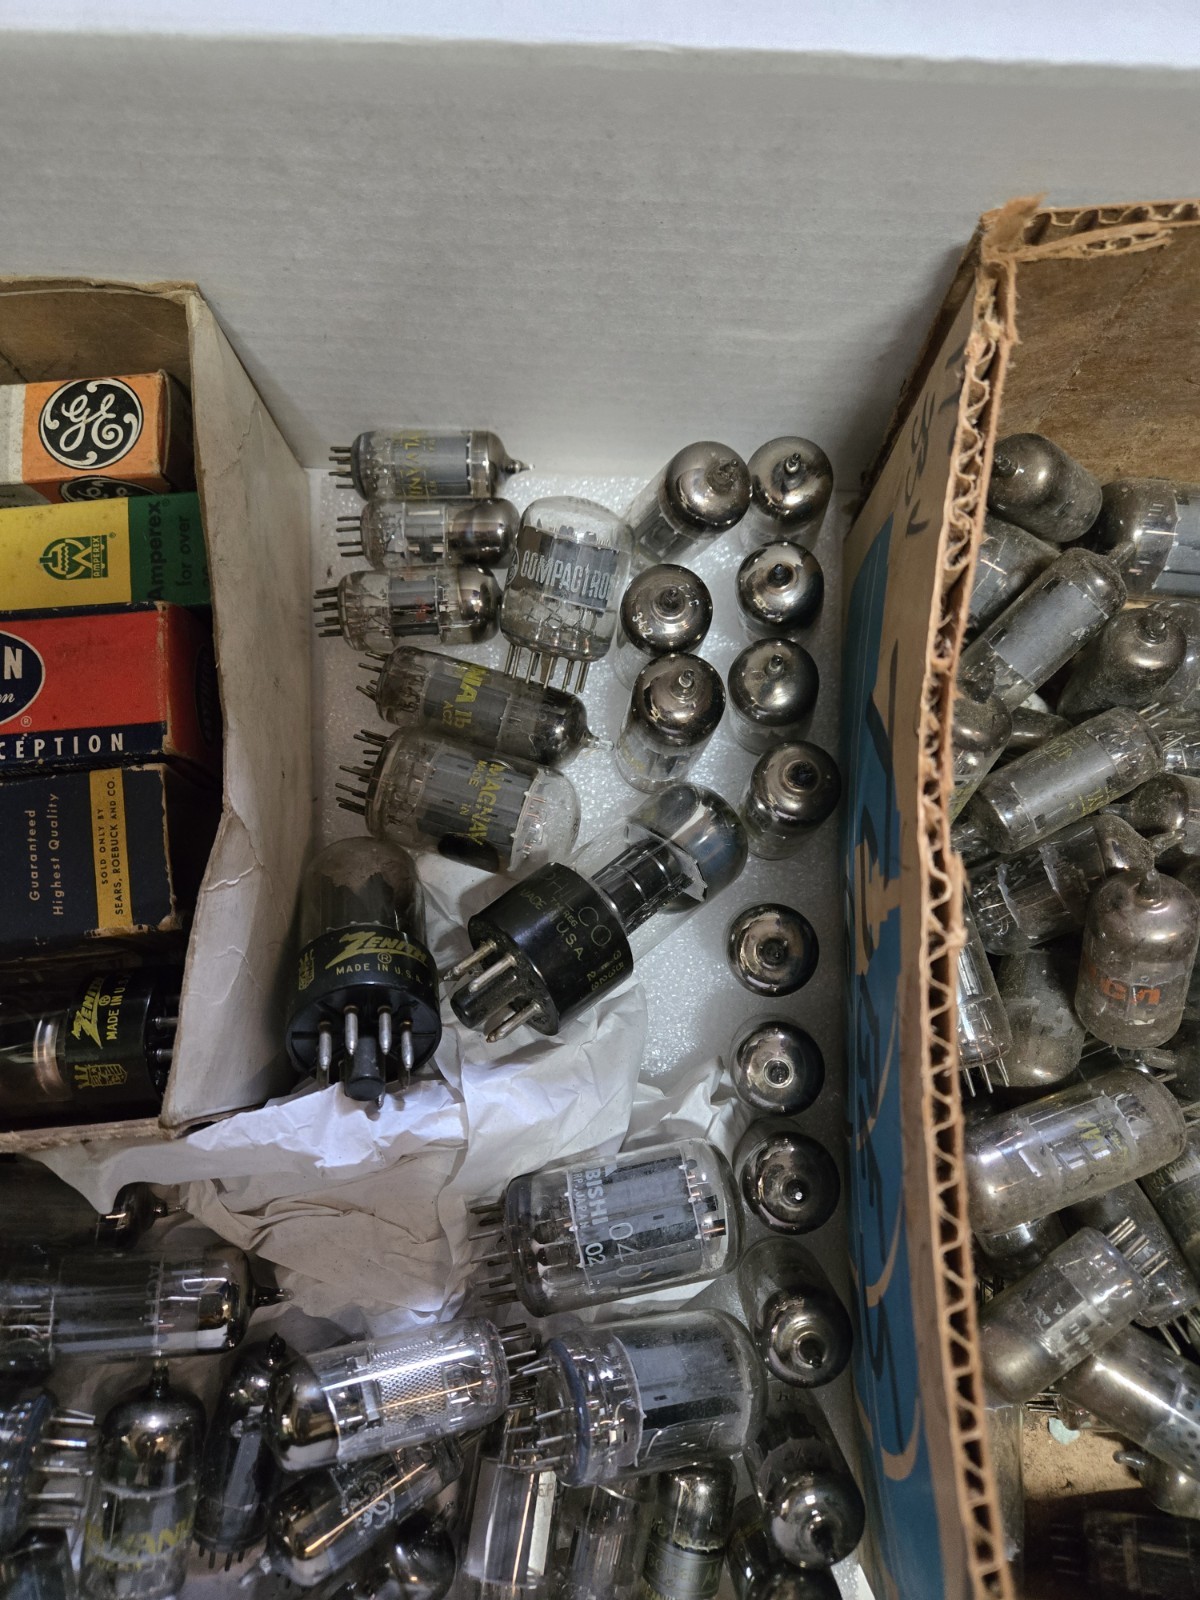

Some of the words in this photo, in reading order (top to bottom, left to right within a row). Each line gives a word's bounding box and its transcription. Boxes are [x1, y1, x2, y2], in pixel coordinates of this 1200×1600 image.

[147, 501, 168, 600] Amperex
[178, 515, 193, 554] over
[93, 535, 101, 578] AMPEREX
[176, 561, 193, 587] for
[107, 776, 116, 796] CO.
[48, 793, 60, 850] Quality
[97, 808, 104, 821] BY
[110, 800, 118, 820] AND
[25, 810, 41, 900] Guaranteed
[98, 825, 107, 858] ONLY
[111, 823, 121, 876] ROEBUCK
[51, 862, 64, 915] Highest
[101, 861, 109, 885] SOLD
[114, 878, 124, 915] SEARS,
[325, 932, 429, 970] ZENITH
[336, 962, 371, 977] MADE
[376, 962, 390, 973] IN
[110, 994, 123, 1006] IN
[106, 1008, 119, 1040] MADE
[585, 1167, 608, 1226] BISHI
[585, 1242, 606, 1267] 02
